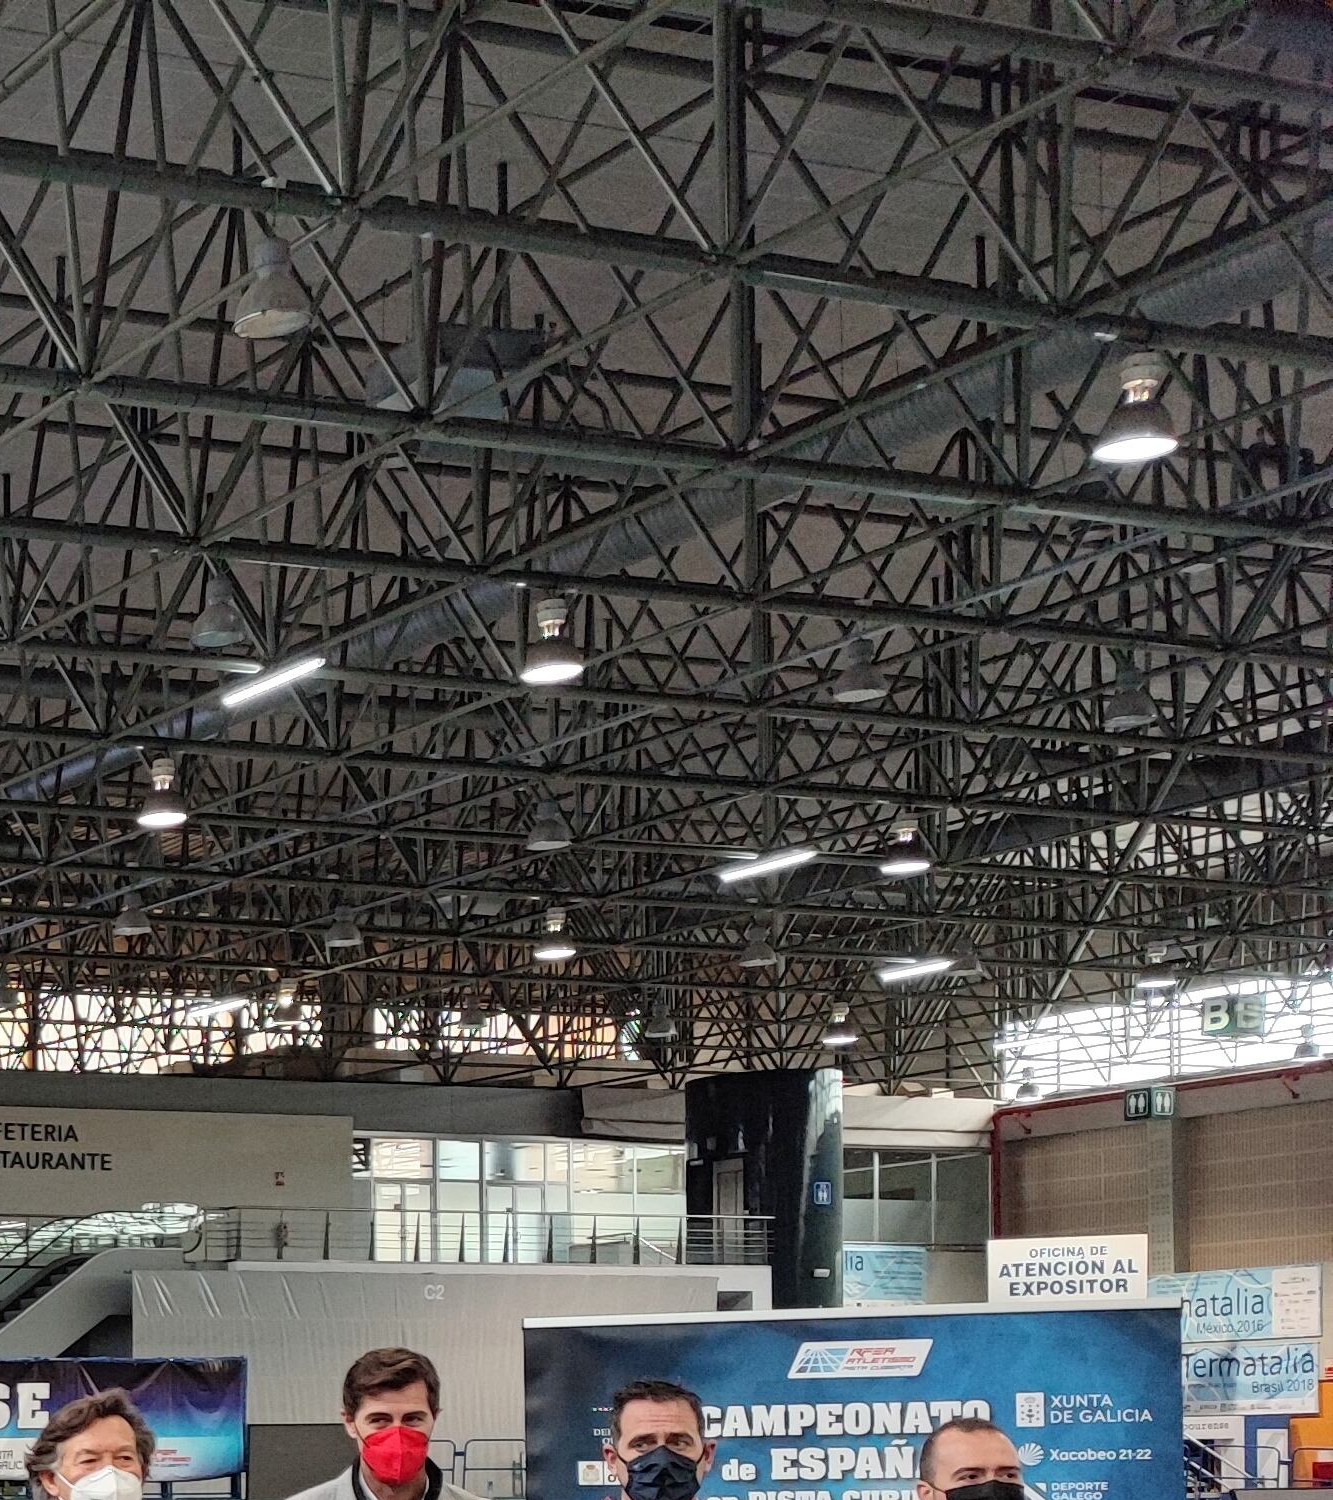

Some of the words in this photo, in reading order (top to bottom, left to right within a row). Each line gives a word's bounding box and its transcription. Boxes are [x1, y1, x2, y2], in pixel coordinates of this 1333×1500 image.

[1204, 999, 1230, 1032] B
[1029, 1246, 1084, 1258] OFICINA
[1090, 1246, 1108, 1256] DE
[999, 1257, 1105, 1278] ATENCIÓN
[1112, 1259, 1139, 1274] AL
[424, 1284, 445, 1300] C2
[1009, 1278, 1128, 1297] EXPOSITOR
[1237, 1320, 1264, 1333] 2016
[850, 1347, 895, 1357] RFEA
[1252, 1381, 1283, 1393] Brasil
[1287, 1379, 1314, 1392] 2018
[1050, 1394, 1113, 1408] XUNTA
[1050, 1410, 1074, 1424] DE
[1079, 1408, 1153, 1424] GALICIA
[721, 1458, 757, 1481] de
[771, 1439, 920, 1481] ESPAÑ
[1049, 1448, 1116, 1461] Xacobeo
[1051, 1481, 1109, 1491] DEPORTE
[1051, 1491, 1102, 1500] GALEGO
